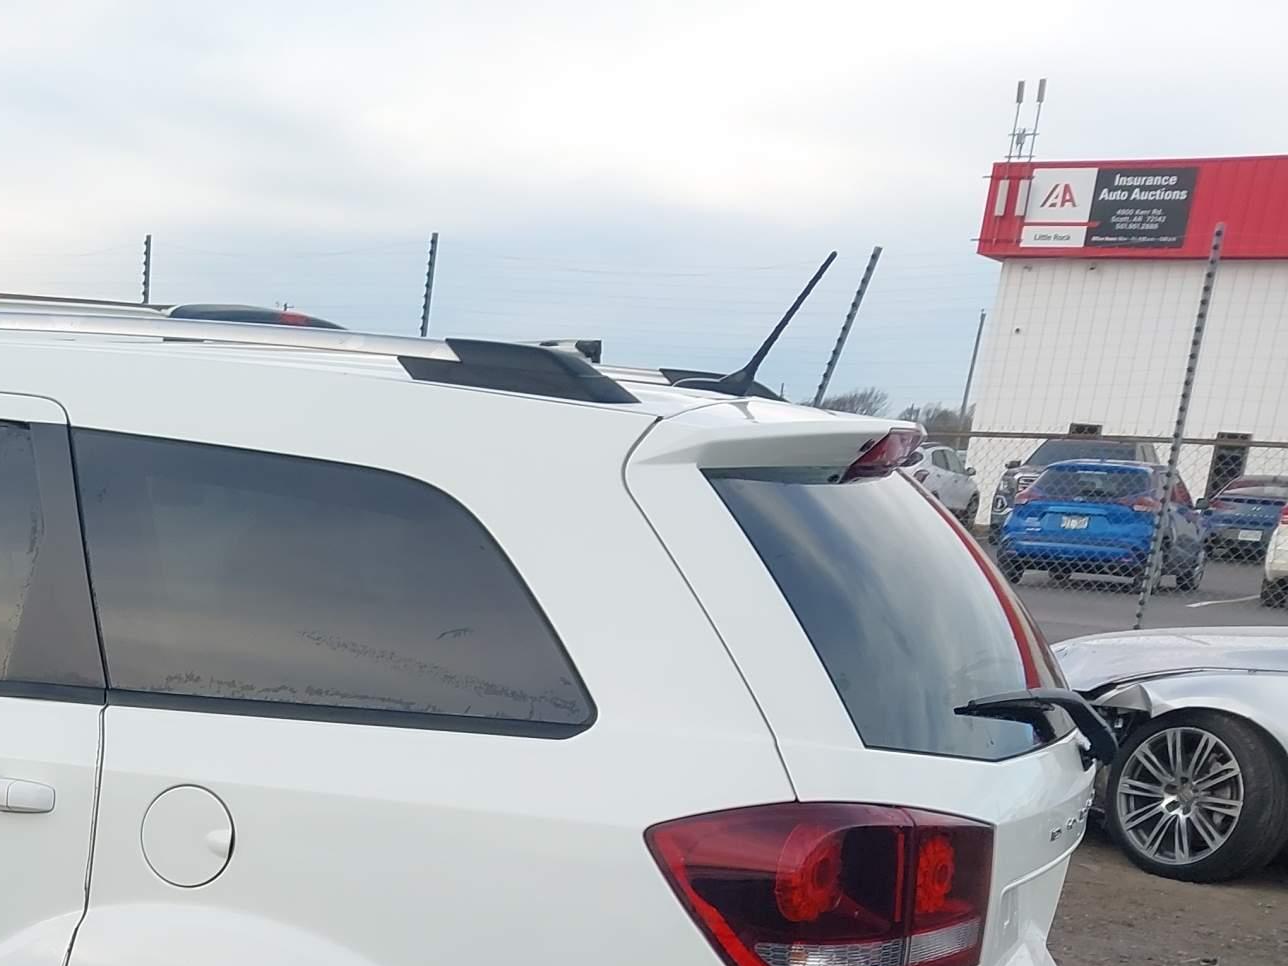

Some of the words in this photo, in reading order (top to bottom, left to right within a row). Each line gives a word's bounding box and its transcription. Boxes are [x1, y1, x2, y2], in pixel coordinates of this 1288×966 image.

[1114, 173, 1178, 186] Insurance
[1098, 188, 1128, 201] Auto
[1130, 187, 1188, 201] Auctions
[1033, 233, 1052, 241] Little
[1053, 233, 1071, 241] Rock
